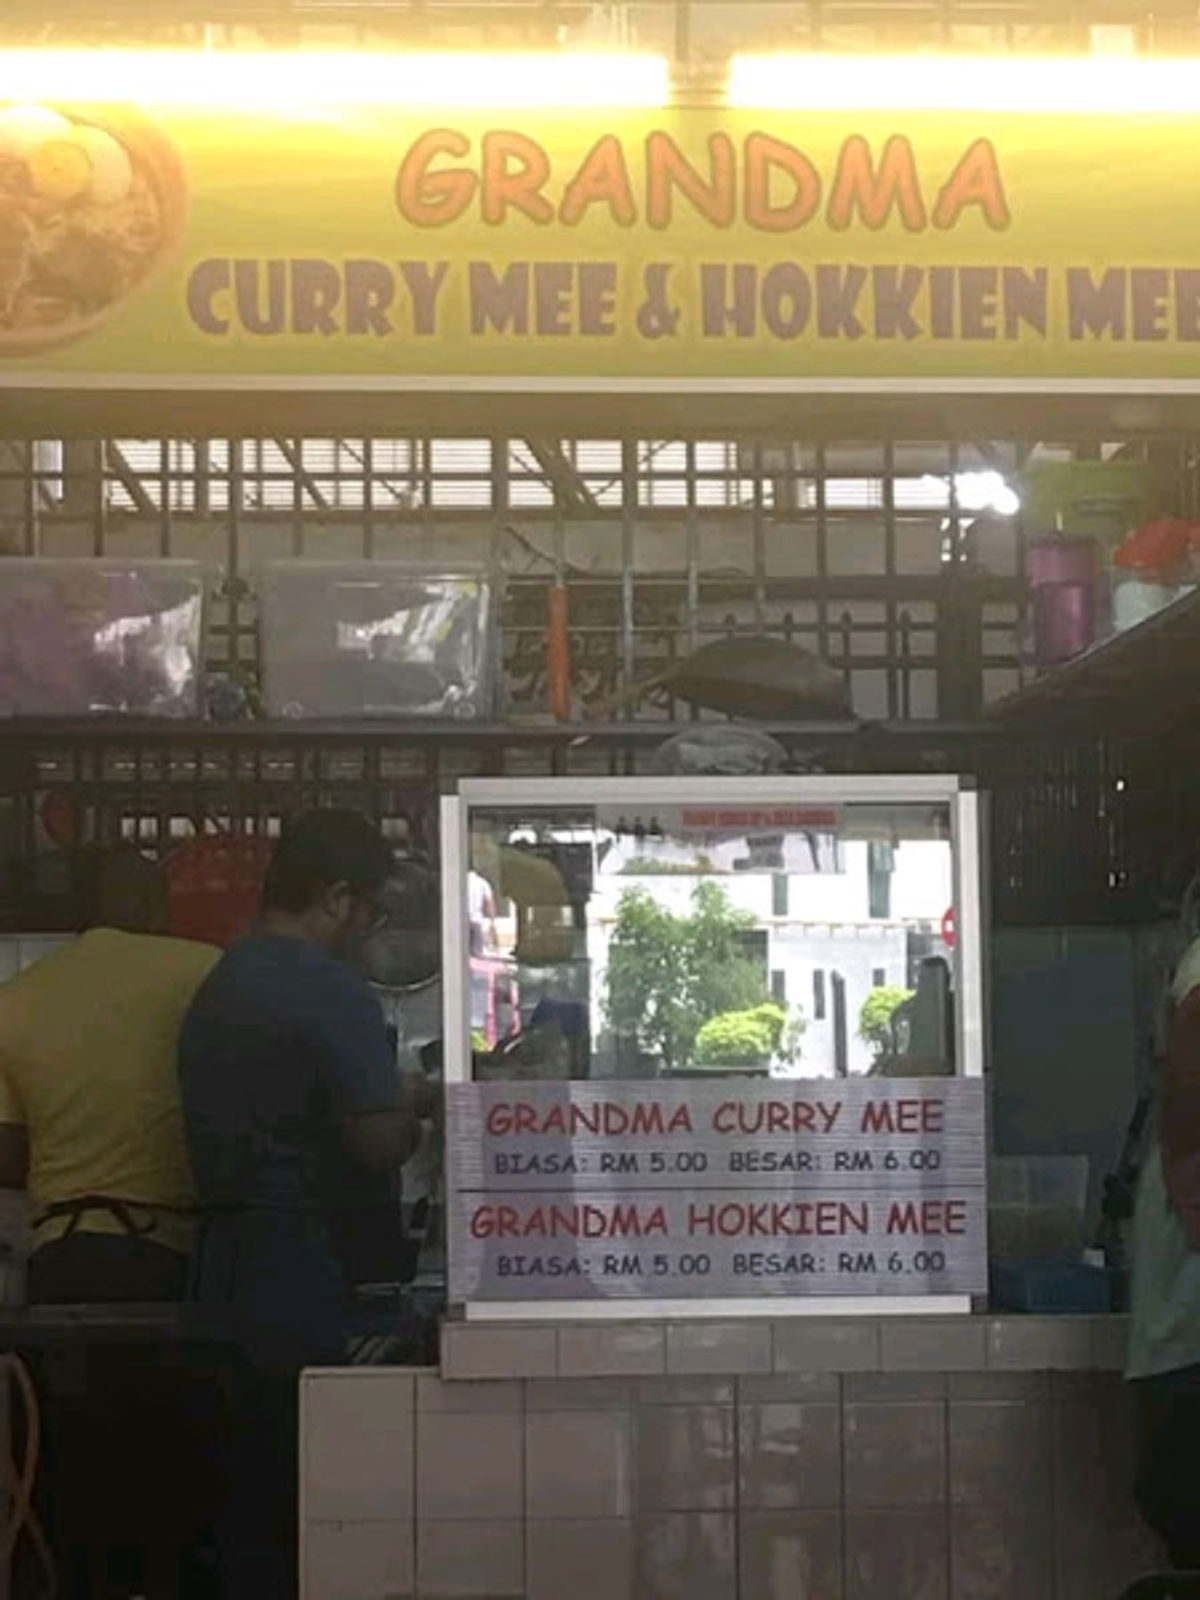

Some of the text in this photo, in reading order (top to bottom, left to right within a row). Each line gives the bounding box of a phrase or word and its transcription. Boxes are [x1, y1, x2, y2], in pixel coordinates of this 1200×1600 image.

[396, 129, 1011, 233] GRANDMA
[187, 258, 449, 337] CURRY
[469, 261, 618, 336] MEE
[637, 262, 680, 341] &
[700, 262, 1048, 341] HOKKIEN
[486, 1099, 944, 1136] GRANDMA CURRY MEE
[494, 1149, 942, 1175] BIASA: RM 5.00 BESAR: RM 6.00
[470, 1200, 968, 1240] GRANDMA HOKKIEN MEE
[497, 1251, 946, 1277] BIASA: RM 5.00 BESAR: RM 6.00
